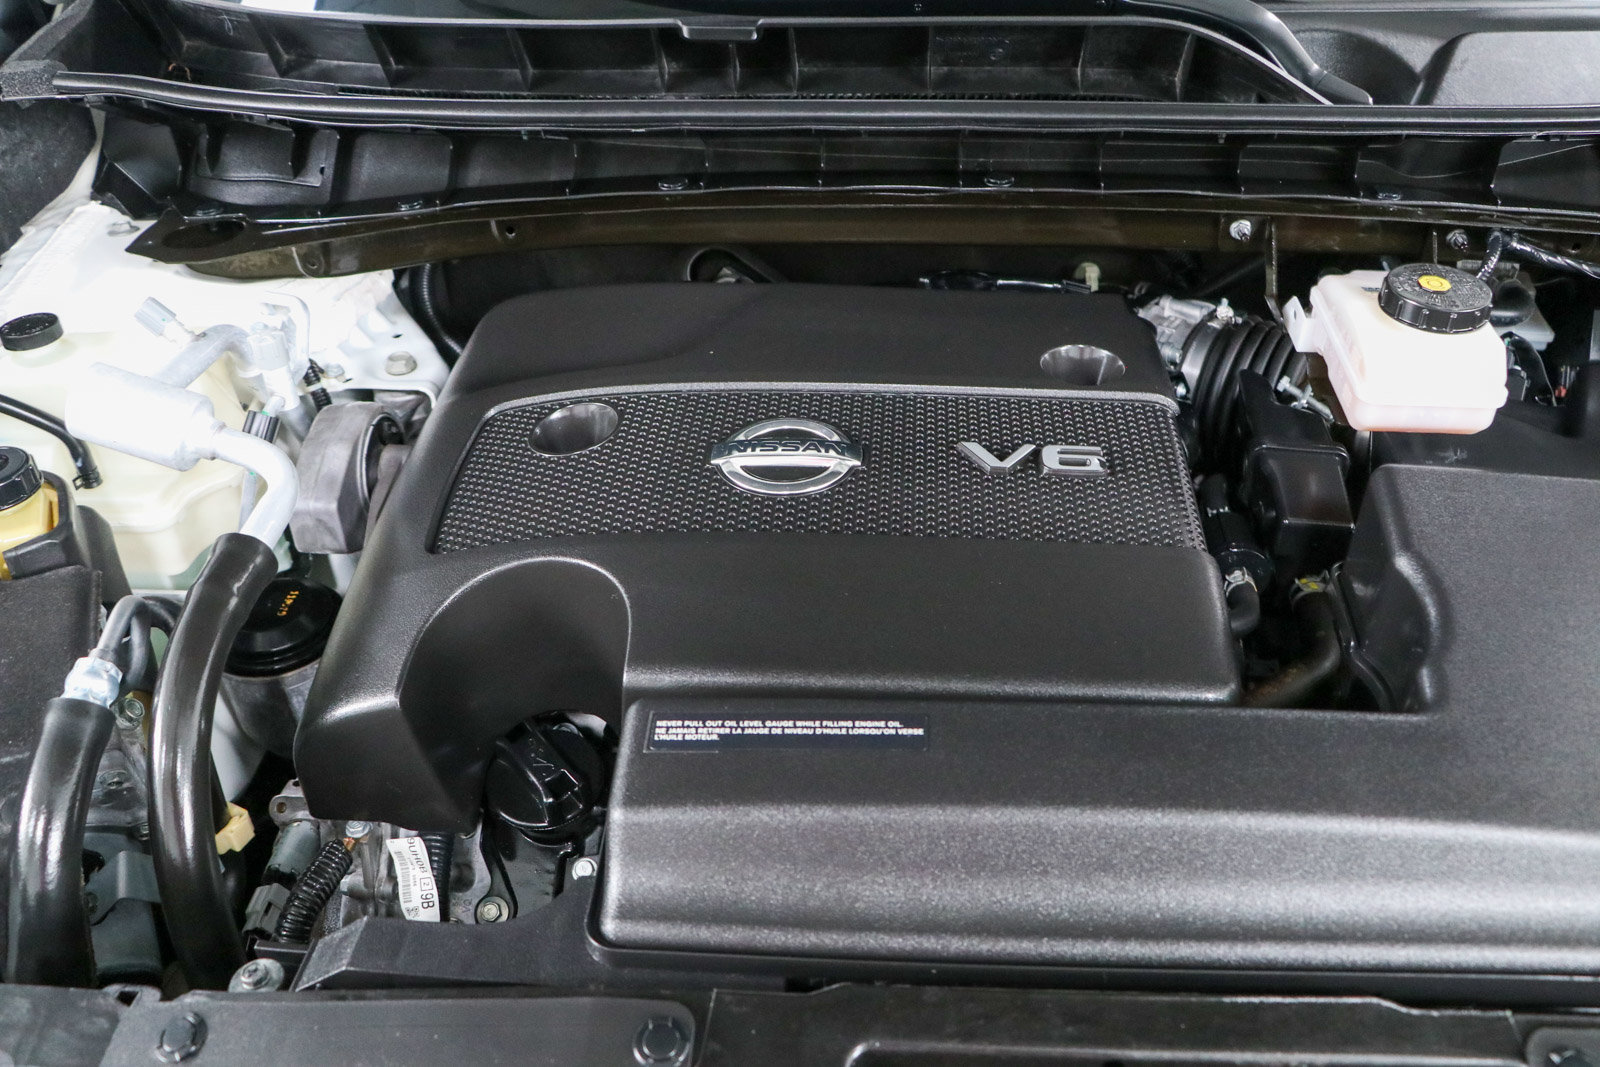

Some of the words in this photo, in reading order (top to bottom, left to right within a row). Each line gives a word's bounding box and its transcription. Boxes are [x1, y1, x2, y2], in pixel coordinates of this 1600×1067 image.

[726, 440, 847, 456] NISSAN
[957, 441, 1107, 476] V6
[822, 720, 853, 728] FILLING
[855, 720, 886, 728] ENGINE
[887, 720, 904, 728] OIL.
[421, 893, 435, 909] 9B
